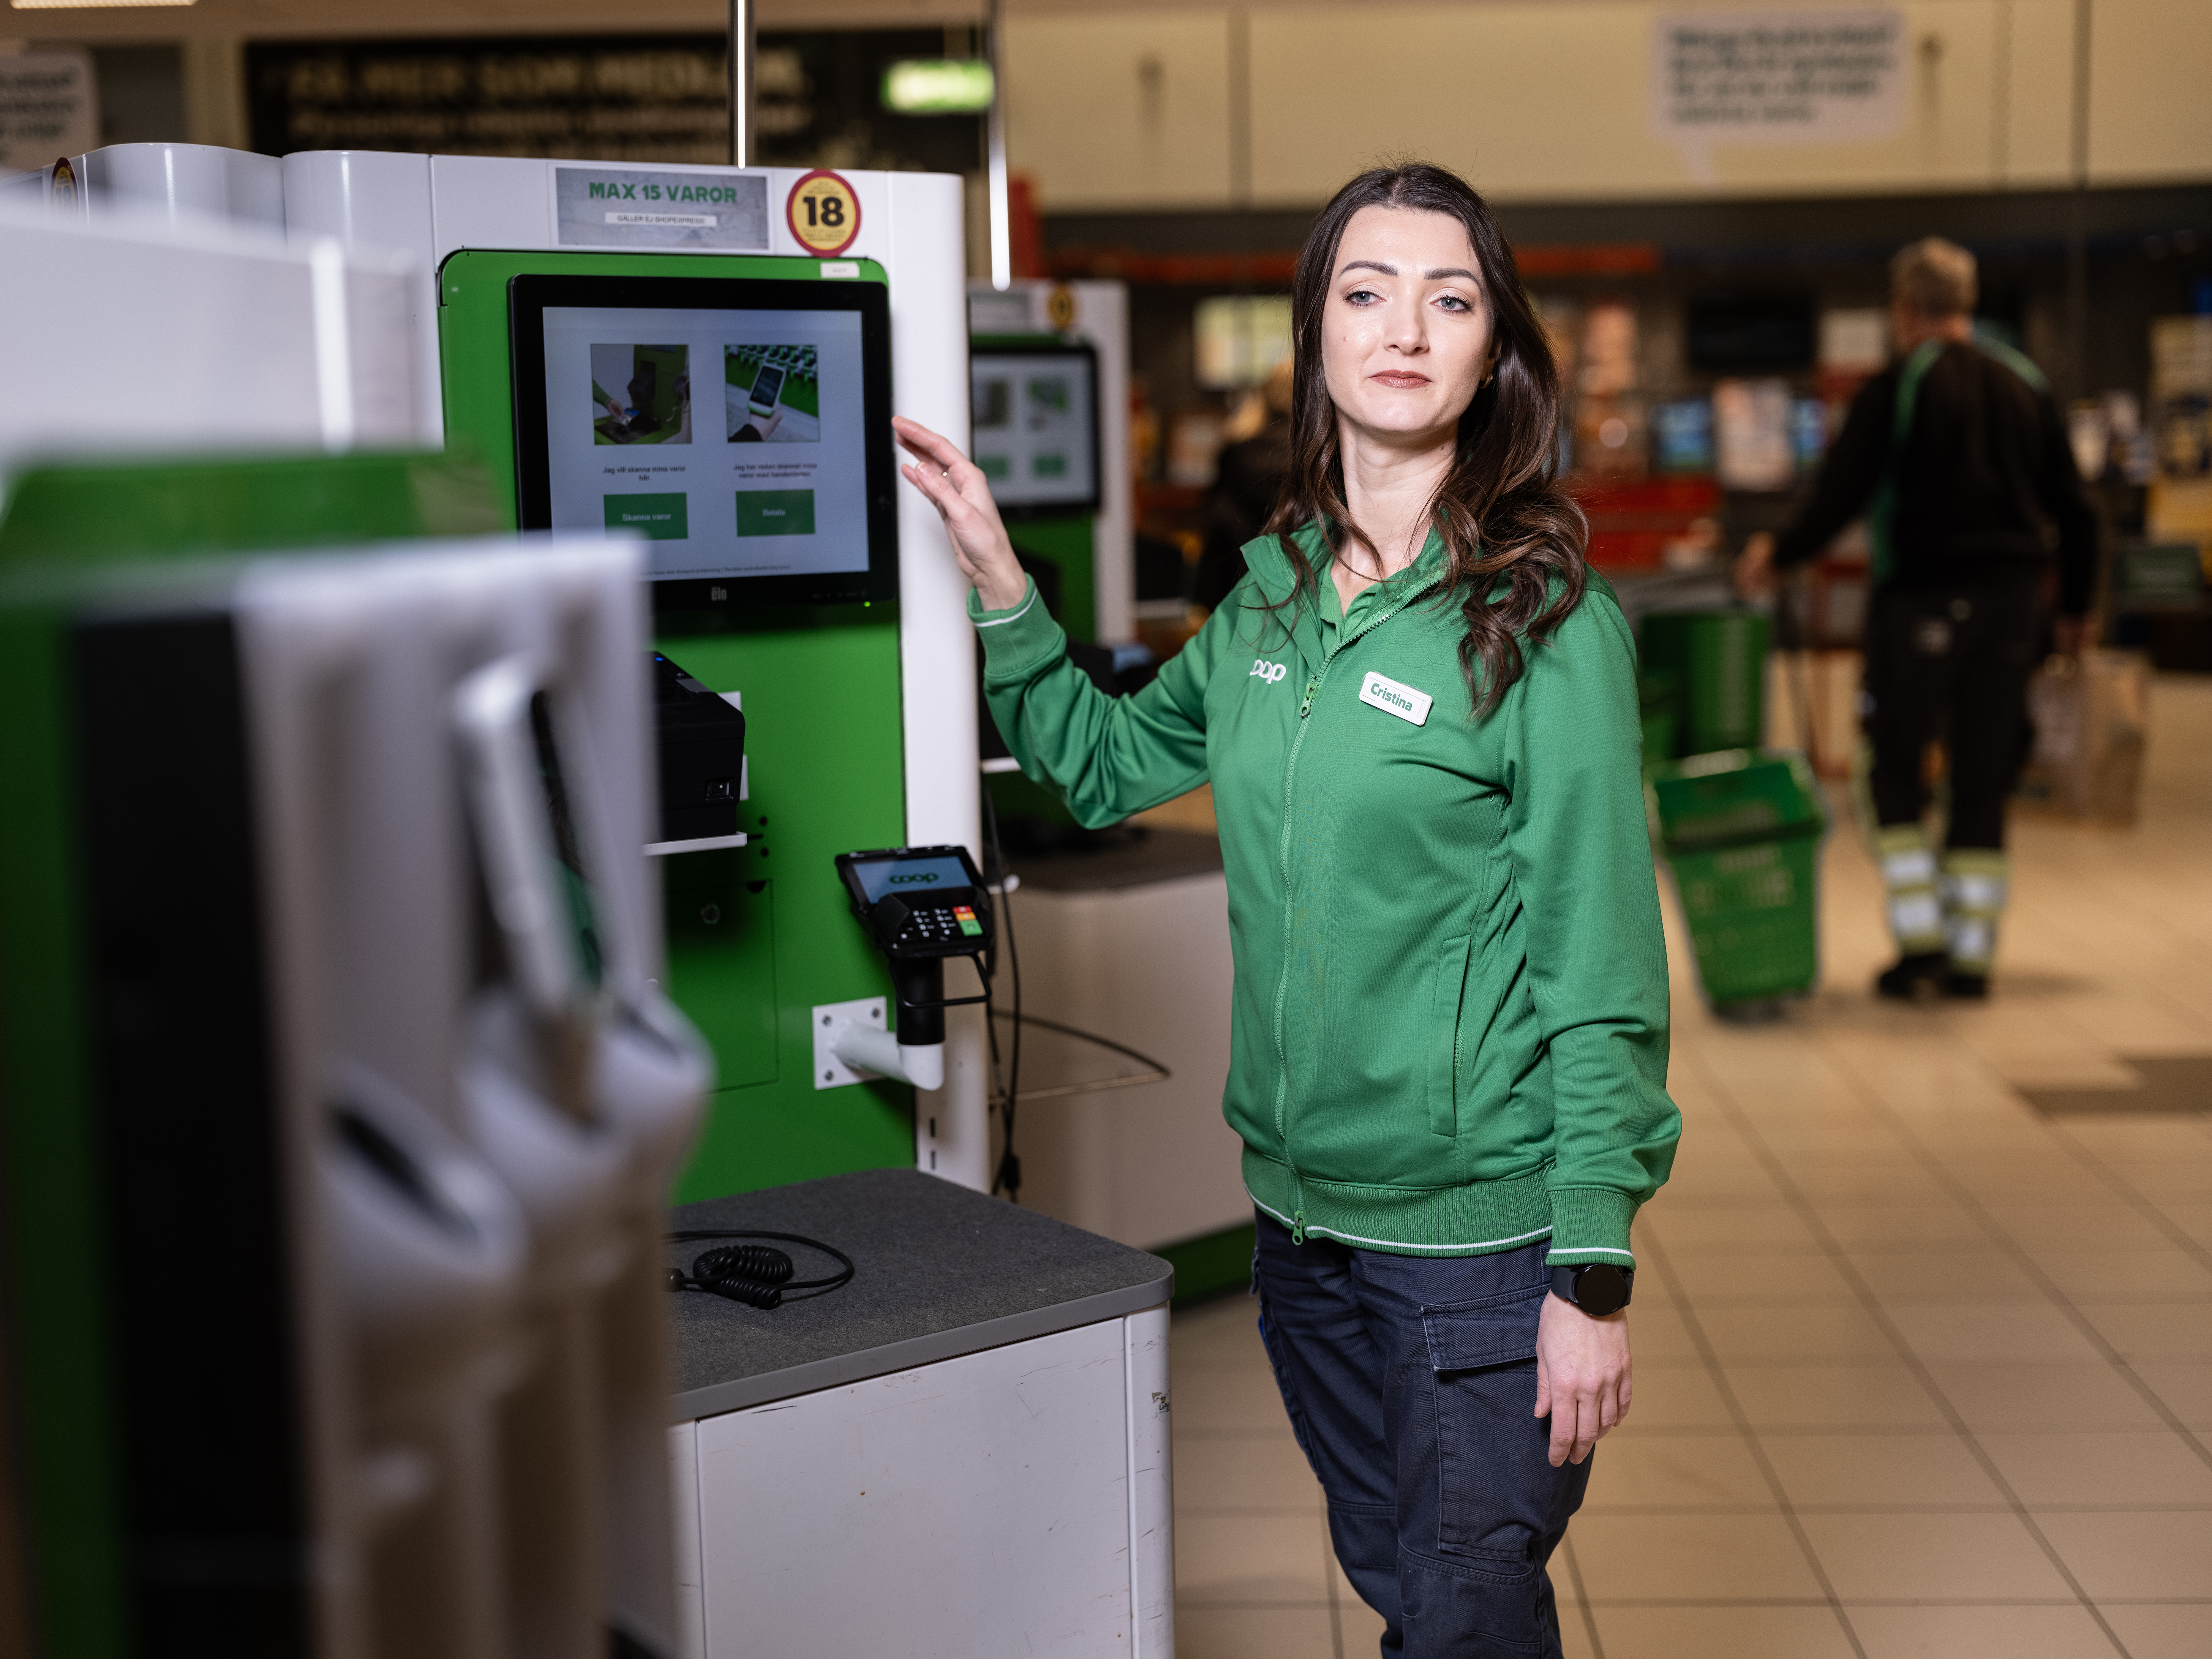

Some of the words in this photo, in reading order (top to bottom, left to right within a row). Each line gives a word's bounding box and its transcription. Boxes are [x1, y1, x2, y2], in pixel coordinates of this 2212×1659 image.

[589, 182, 637, 200] MAX
[642, 184, 661, 200] 15
[666, 185, 737, 203] VAROR
[804, 196, 844, 226] 18
[622, 513, 650, 521] Skanna
[1249, 659, 1286, 684] oop
[1371, 683, 1413, 712] Cristina
[890, 873, 940, 884] coop
